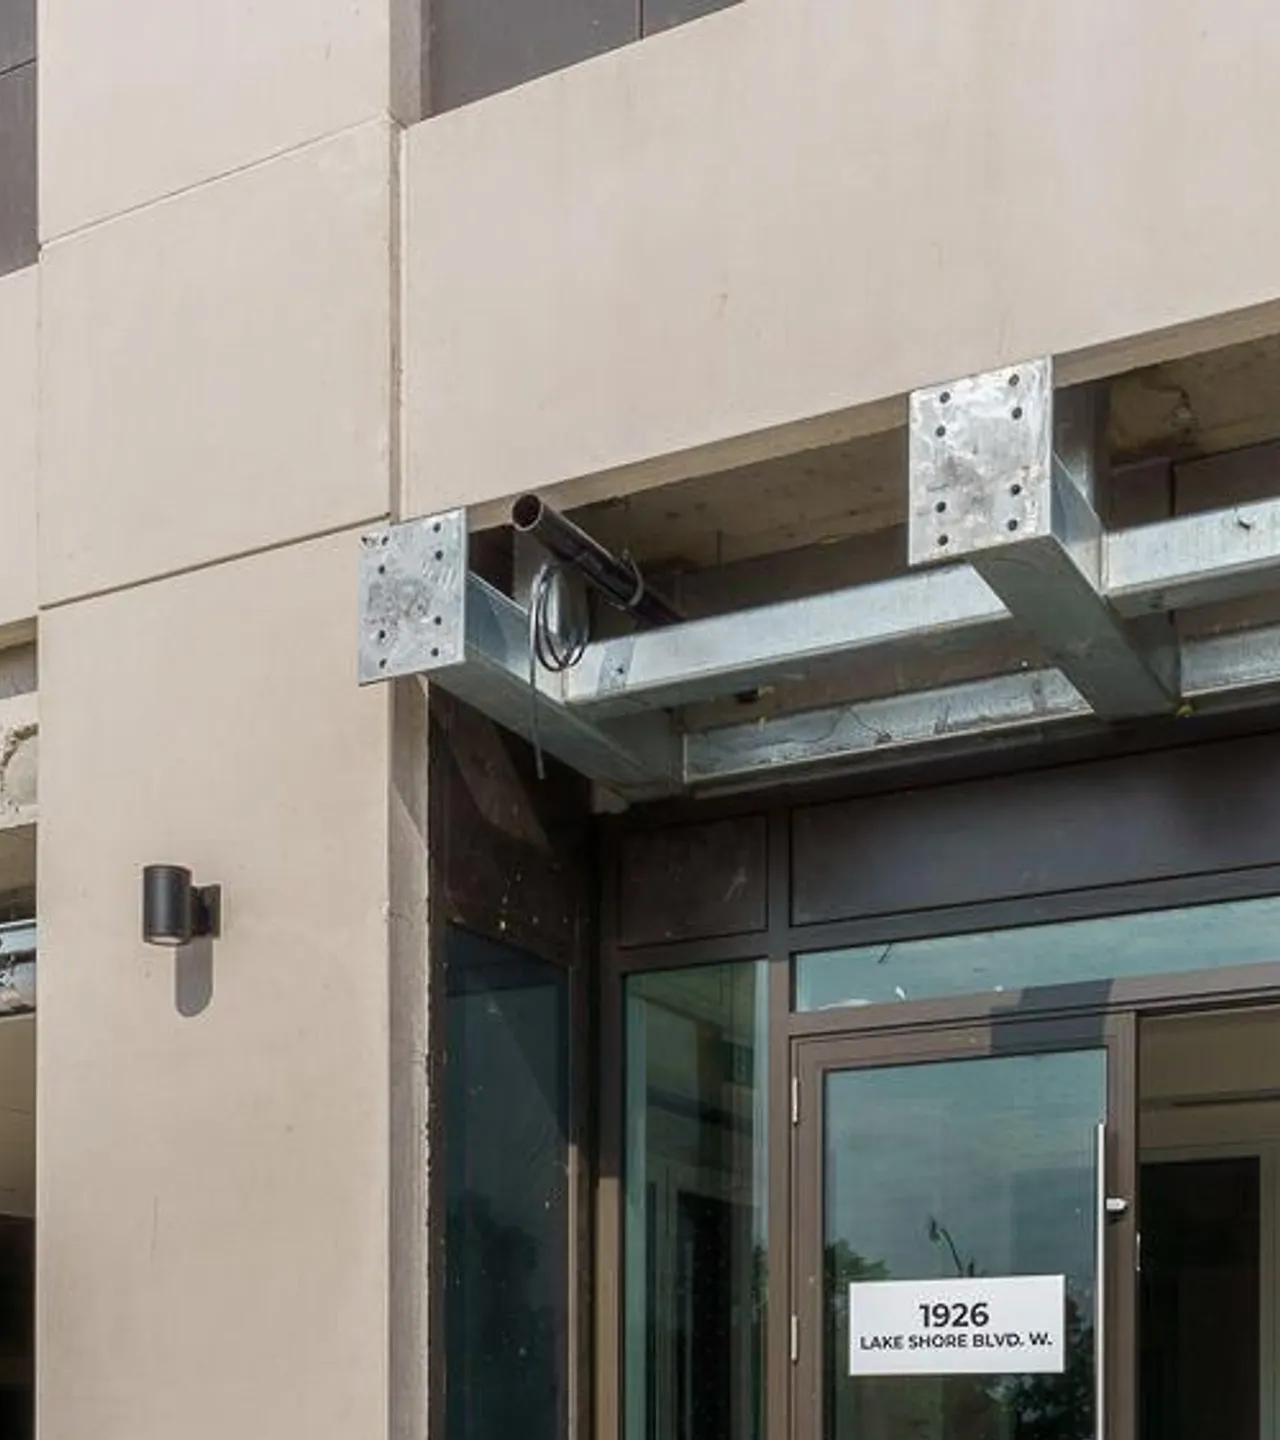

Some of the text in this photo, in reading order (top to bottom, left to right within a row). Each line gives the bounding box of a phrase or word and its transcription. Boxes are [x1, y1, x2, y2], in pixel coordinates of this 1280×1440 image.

[918, 1302, 989, 1328] 1926
[860, 1331, 1053, 1350] LAKE SHORE BLVD. W.
